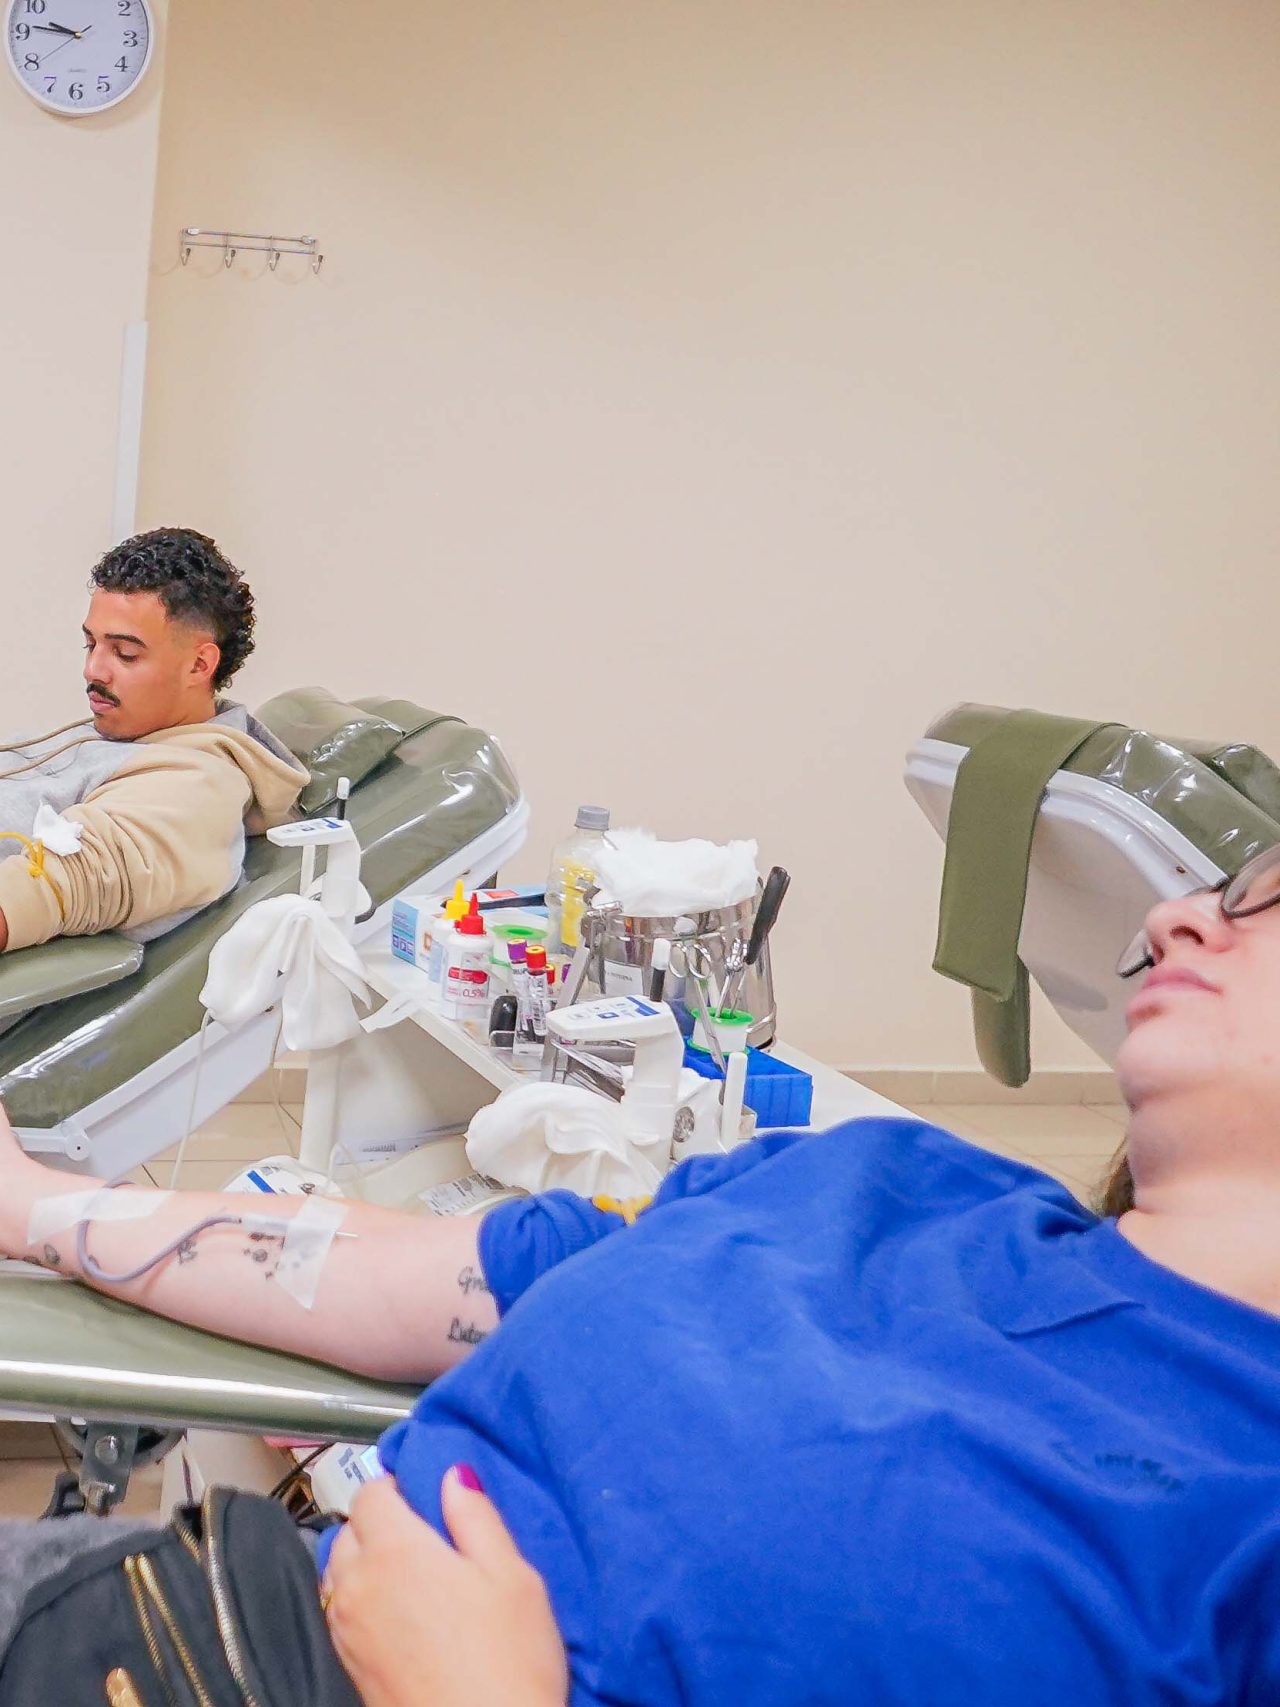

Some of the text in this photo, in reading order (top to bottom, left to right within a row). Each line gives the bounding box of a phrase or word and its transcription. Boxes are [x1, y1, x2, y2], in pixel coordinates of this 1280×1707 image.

[24, 0, 46, 14] 10
[117, 1, 131, 16] 2
[15, 22, 31, 41] 9
[122, 30, 138, 48] 3
[24, 52, 40, 72] 8
[114, 55, 129, 73] 4
[43, 76, 57, 94] 7
[69, 82, 84, 101] 6
[96, 75, 111, 93] 5
